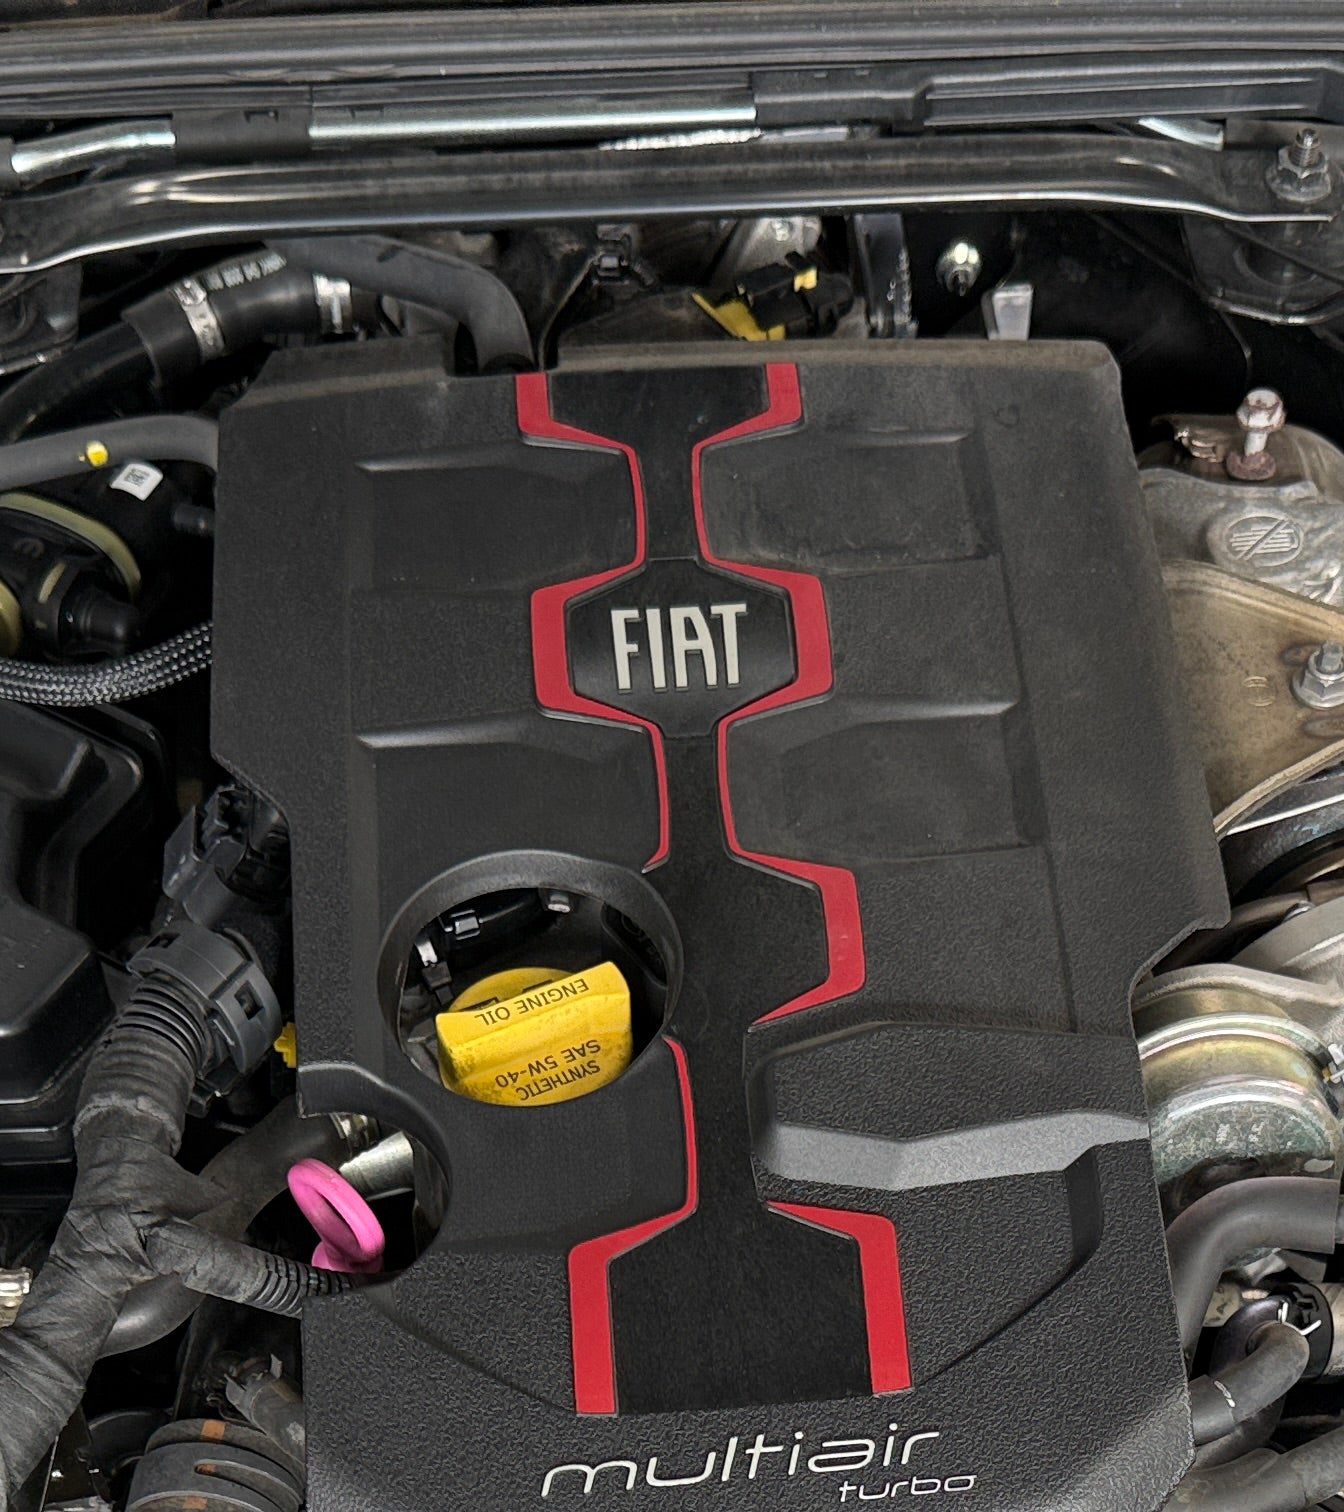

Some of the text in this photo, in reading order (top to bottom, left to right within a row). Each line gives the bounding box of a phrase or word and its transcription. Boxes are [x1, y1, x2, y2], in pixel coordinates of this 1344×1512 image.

[611, 603, 748, 692] FIAT
[475, 979, 588, 1025] ENGINE OIL
[495, 1039, 600, 1087] SAE 5W-40
[516, 1060, 599, 1100] SYNTHETIC
[540, 1422, 940, 1498] multiair
[838, 1474, 978, 1502] turbo
